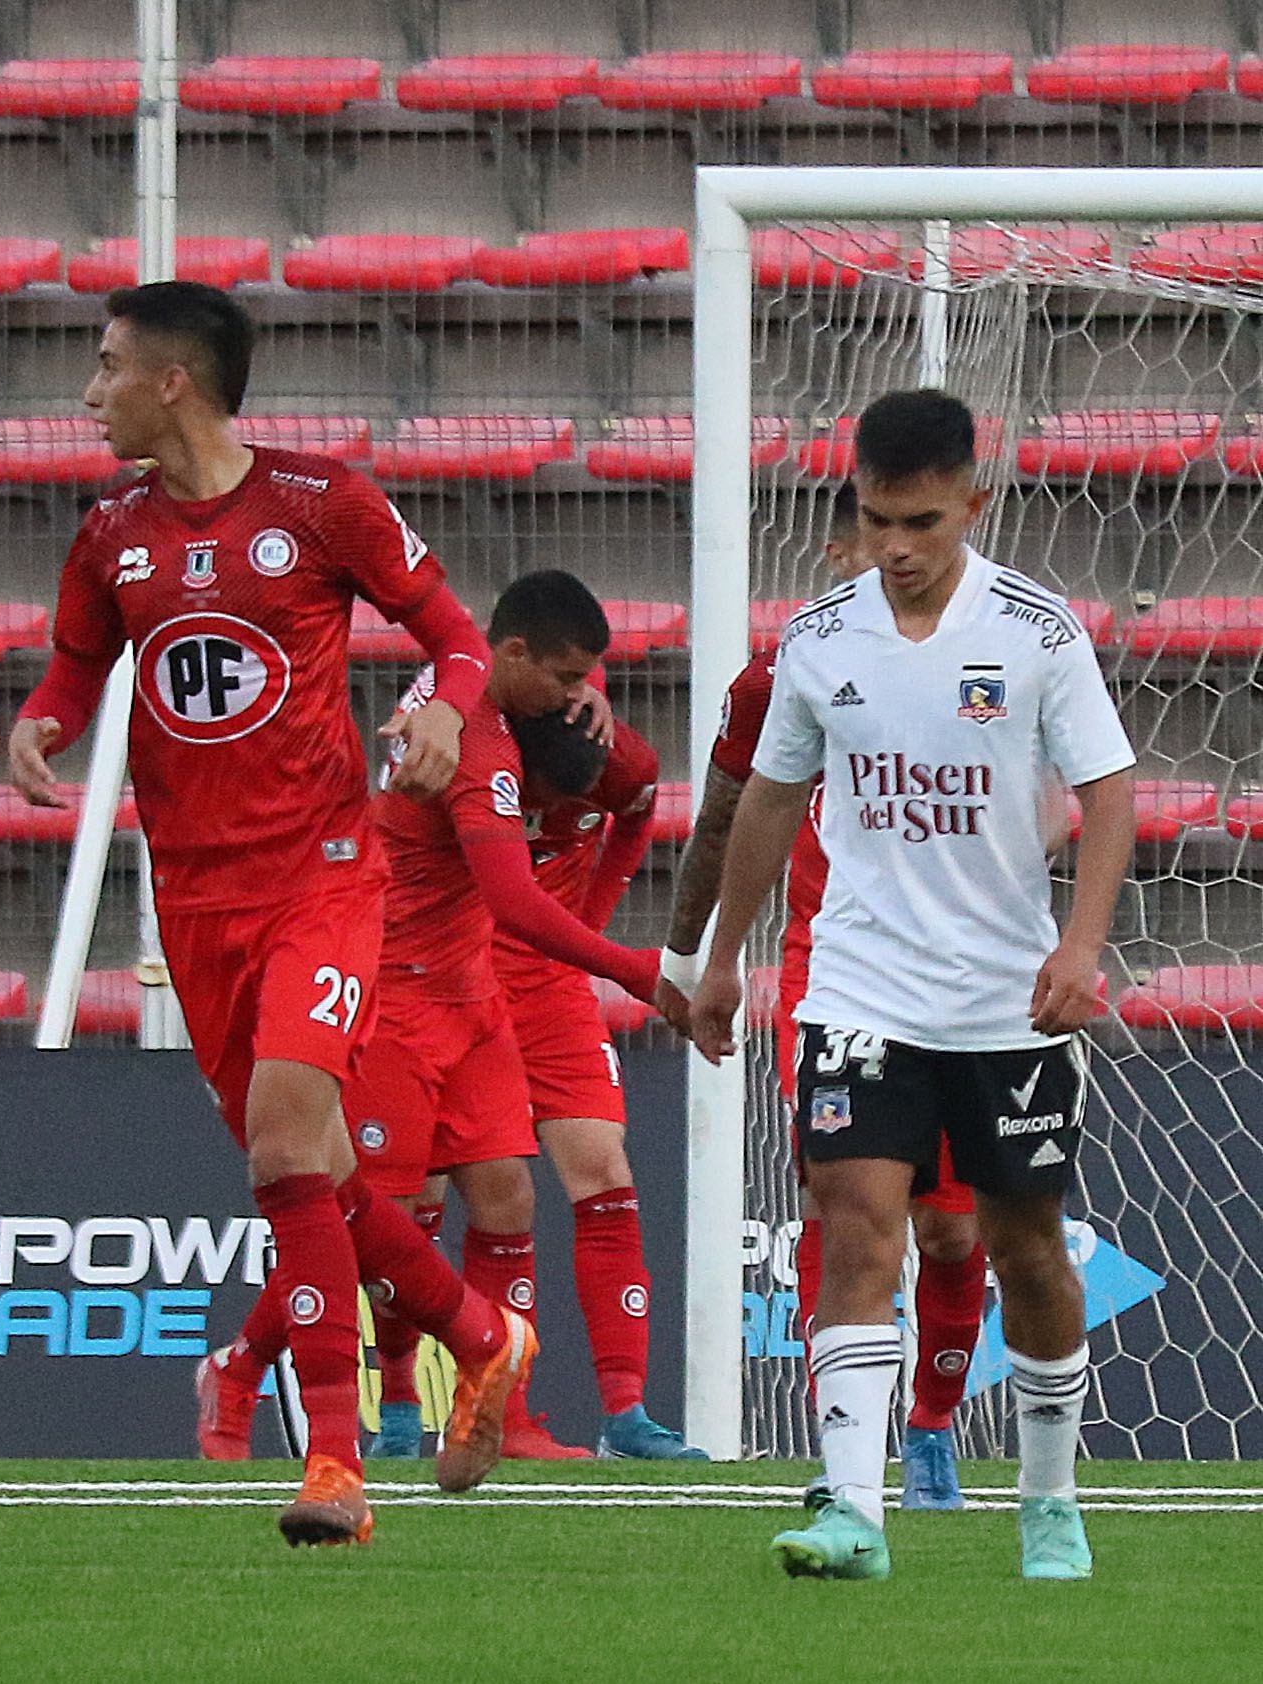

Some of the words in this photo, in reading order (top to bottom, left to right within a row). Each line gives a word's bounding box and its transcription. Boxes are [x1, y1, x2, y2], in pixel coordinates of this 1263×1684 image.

[816, 618, 844, 639] GO
[167, 637, 244, 717] PF
[848, 751, 992, 797] Pilsen
[859, 802, 894, 832] del
[902, 798, 988, 844] Sur
[309, 966, 362, 1035] 29
[817, 1025, 889, 1081] 34
[997, 1112, 1064, 1138] Rexona
